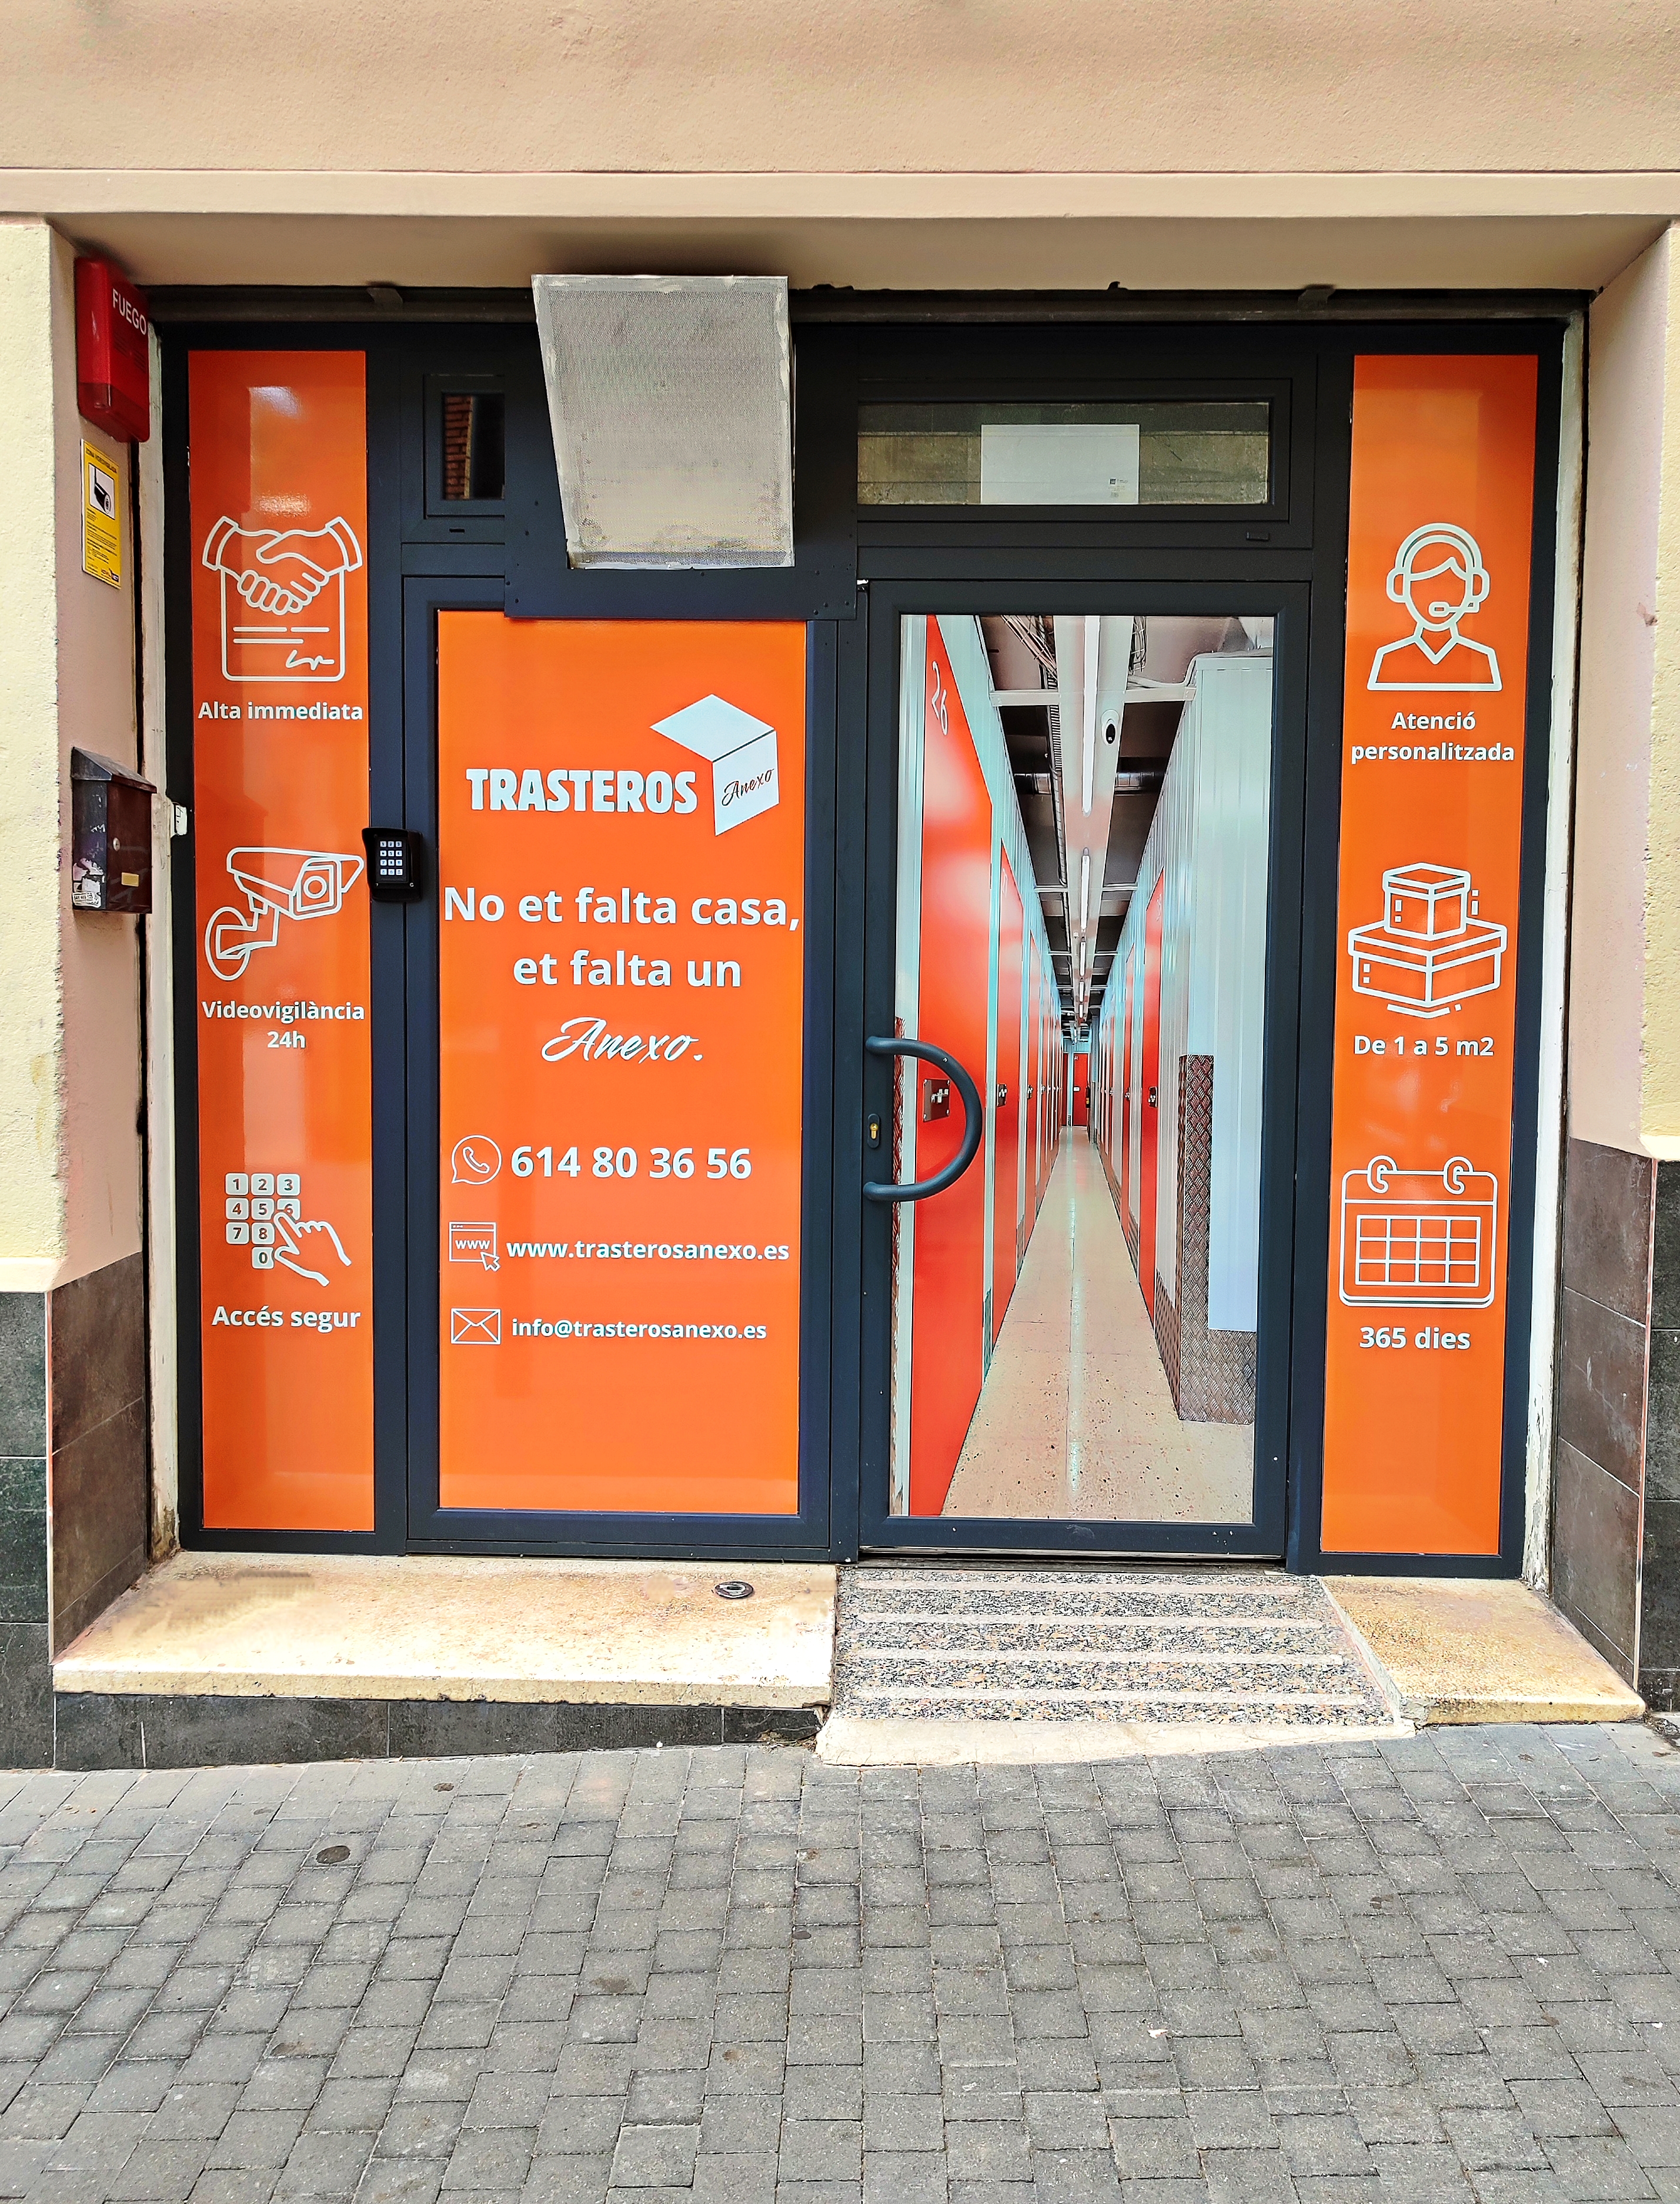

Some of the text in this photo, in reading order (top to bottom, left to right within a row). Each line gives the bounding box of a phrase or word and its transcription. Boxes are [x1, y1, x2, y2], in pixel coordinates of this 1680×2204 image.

[113, 287, 146, 335] FUEGO
[931, 660, 948, 736] 26
[198, 701, 363, 720] Alta immediata
[1391, 712, 1476, 730] Atenció
[1351, 742, 1514, 764] personalitzada
[466, 768, 698, 814] TRASTEROS
[722, 768, 775, 806] Anexo
[445, 887, 800, 931] No et falta casa,
[513, 949, 742, 987] et falta un
[201, 1000, 365, 1024] Videovigilància
[266, 1030, 306, 1048] 24h
[541, 1017, 703, 1064] Anexo.
[1354, 1036, 1494, 1056] De 1 a 5 m2
[511, 1146, 752, 1179] 614 80 36 56
[232, 1178, 293, 1191] 1 2 3
[232, 1203, 242, 1215] 4
[258, 1203, 267, 1215] 5
[233, 1227, 268, 1240] 7 8
[506, 1240, 790, 1261] www.trasterosanexo.es
[212, 1305, 361, 1333] Accés segur
[512, 1318, 767, 1340] info@trasterosanexo.es
[1359, 1327, 1471, 1350] 365 dies
